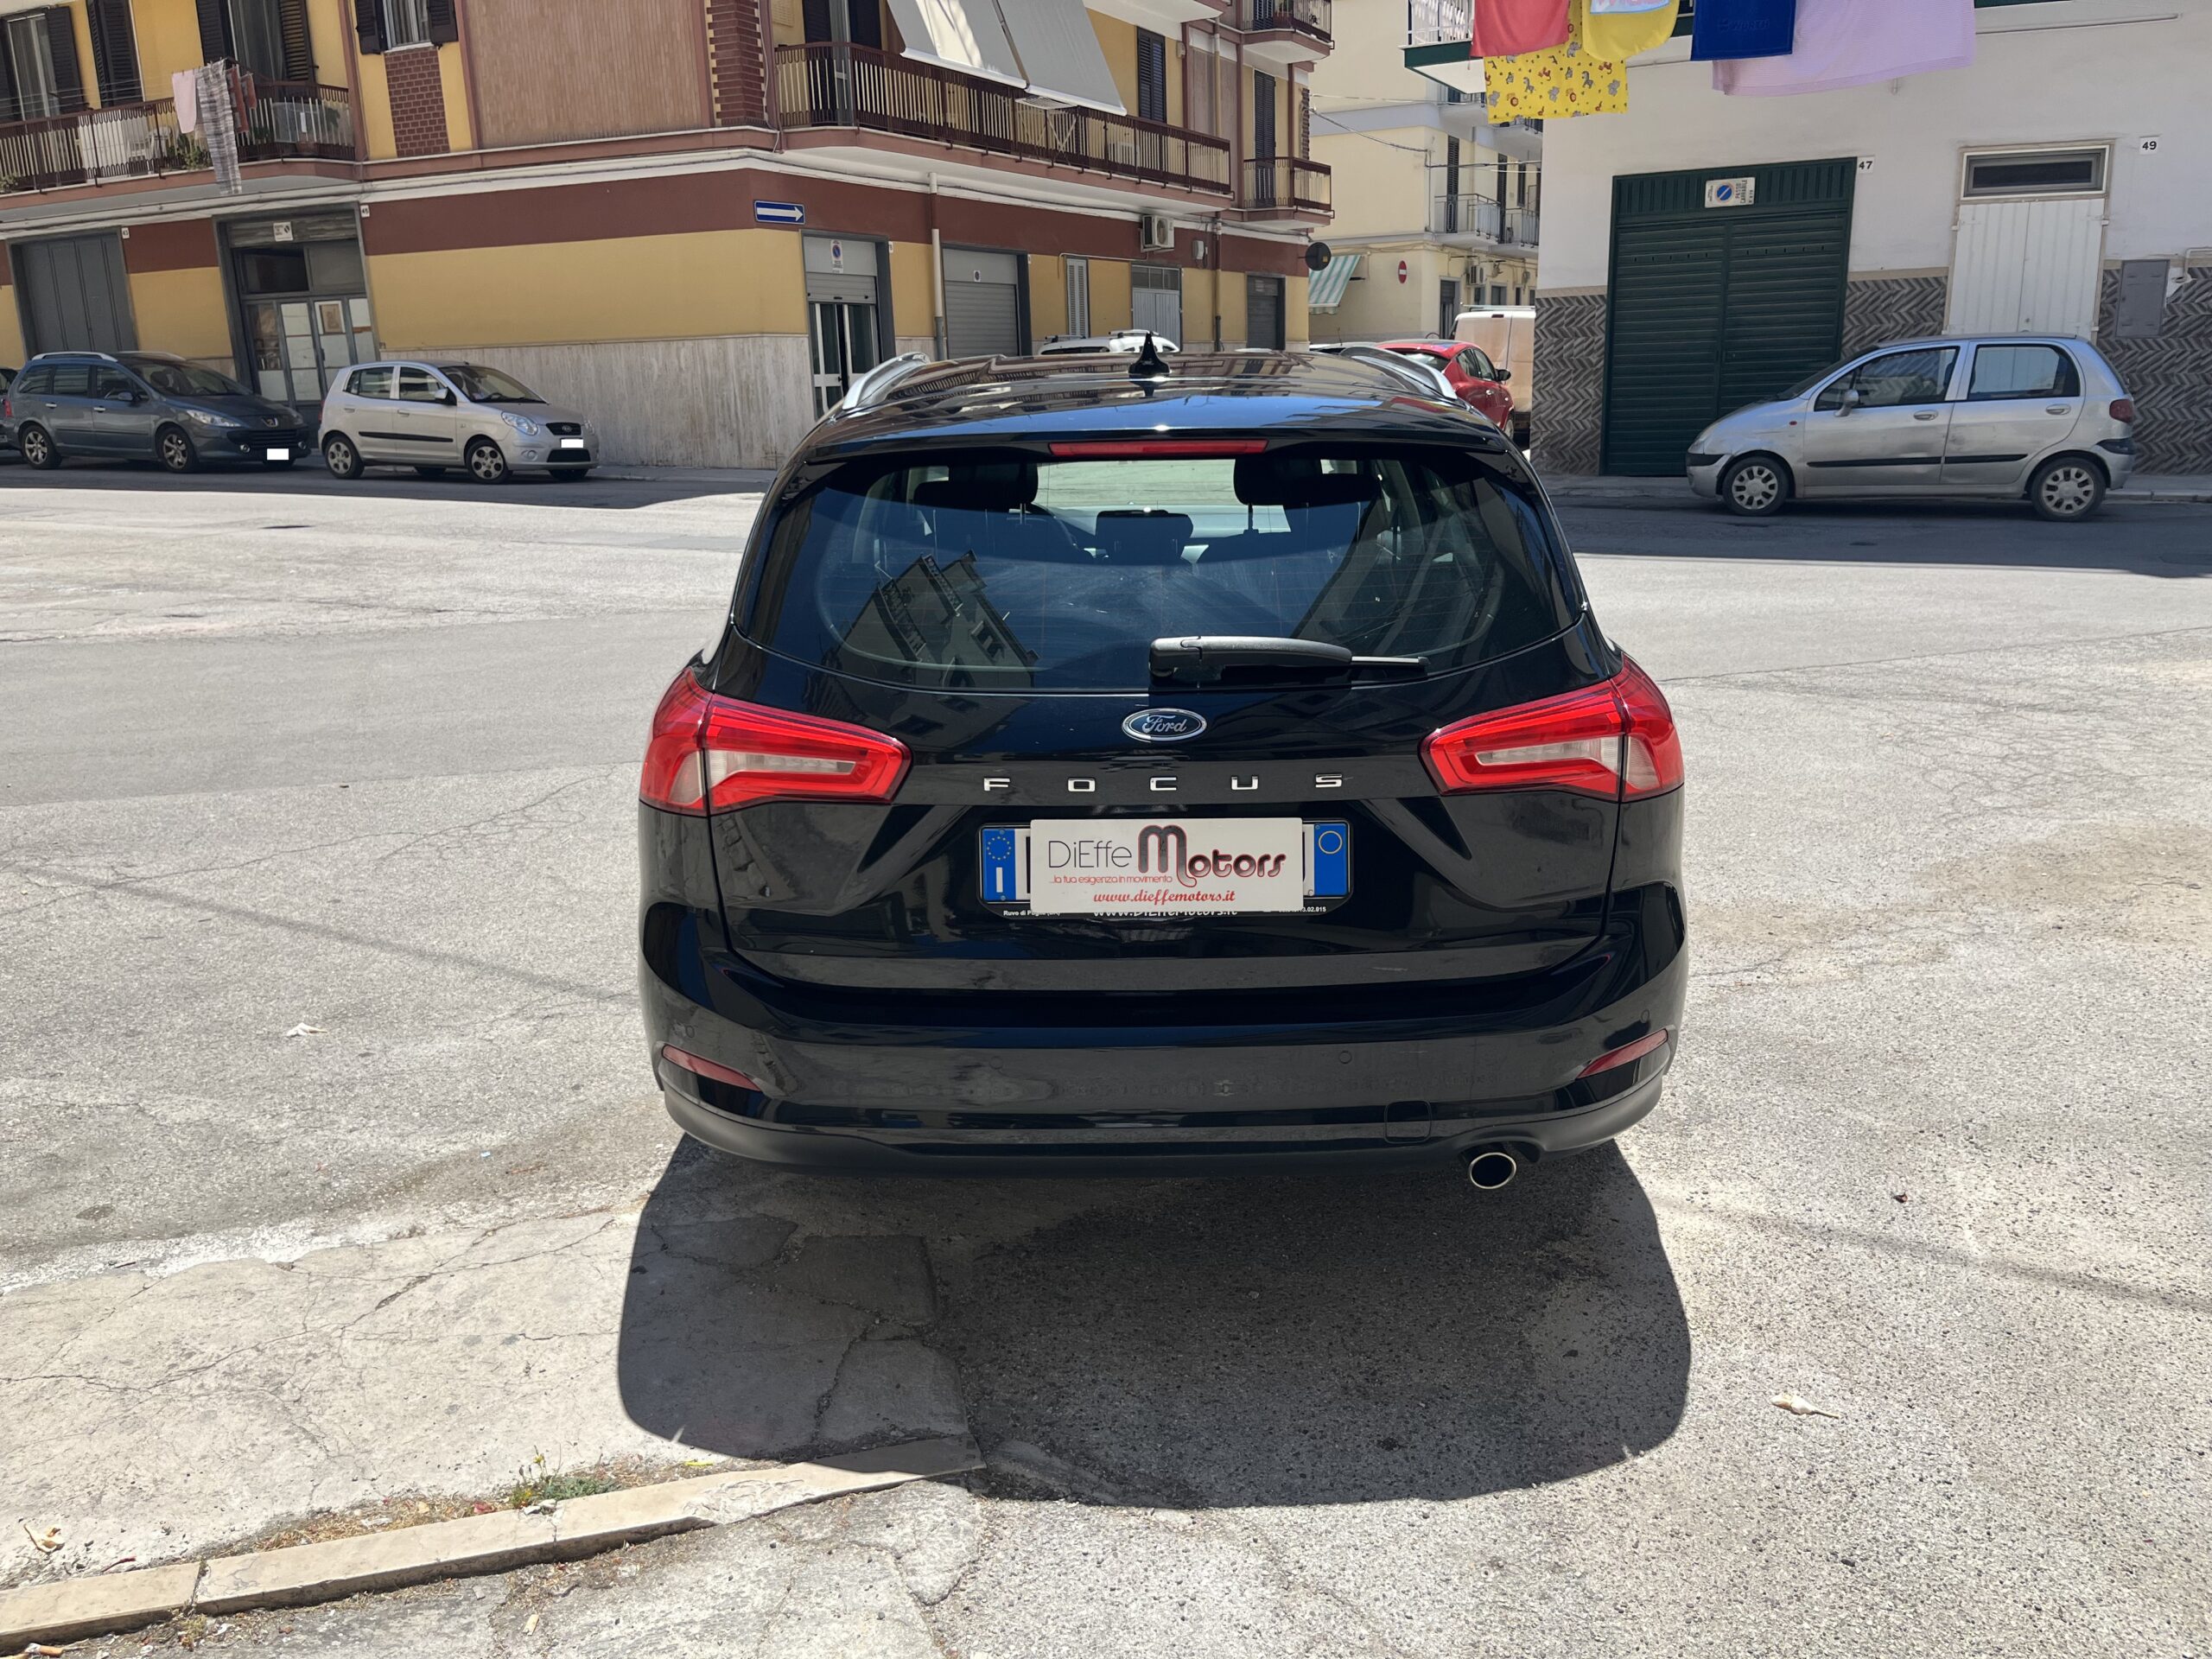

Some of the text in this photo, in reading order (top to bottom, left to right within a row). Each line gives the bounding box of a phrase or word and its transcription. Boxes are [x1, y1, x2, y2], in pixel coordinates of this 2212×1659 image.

[2142, 141, 2158, 150] 49
[1859, 161, 1873, 170] 47
[1141, 714, 1188, 734] Ford
[983, 773, 1343, 792] FOCUS
[1048, 824, 1287, 888] DiEffe Motors
[1063, 874, 1077, 884] tua
[1077, 874, 1118, 886] esigenza
[1126, 874, 1173, 884] movimento
[1092, 888, 1236, 906] www.dieffemotors.it
